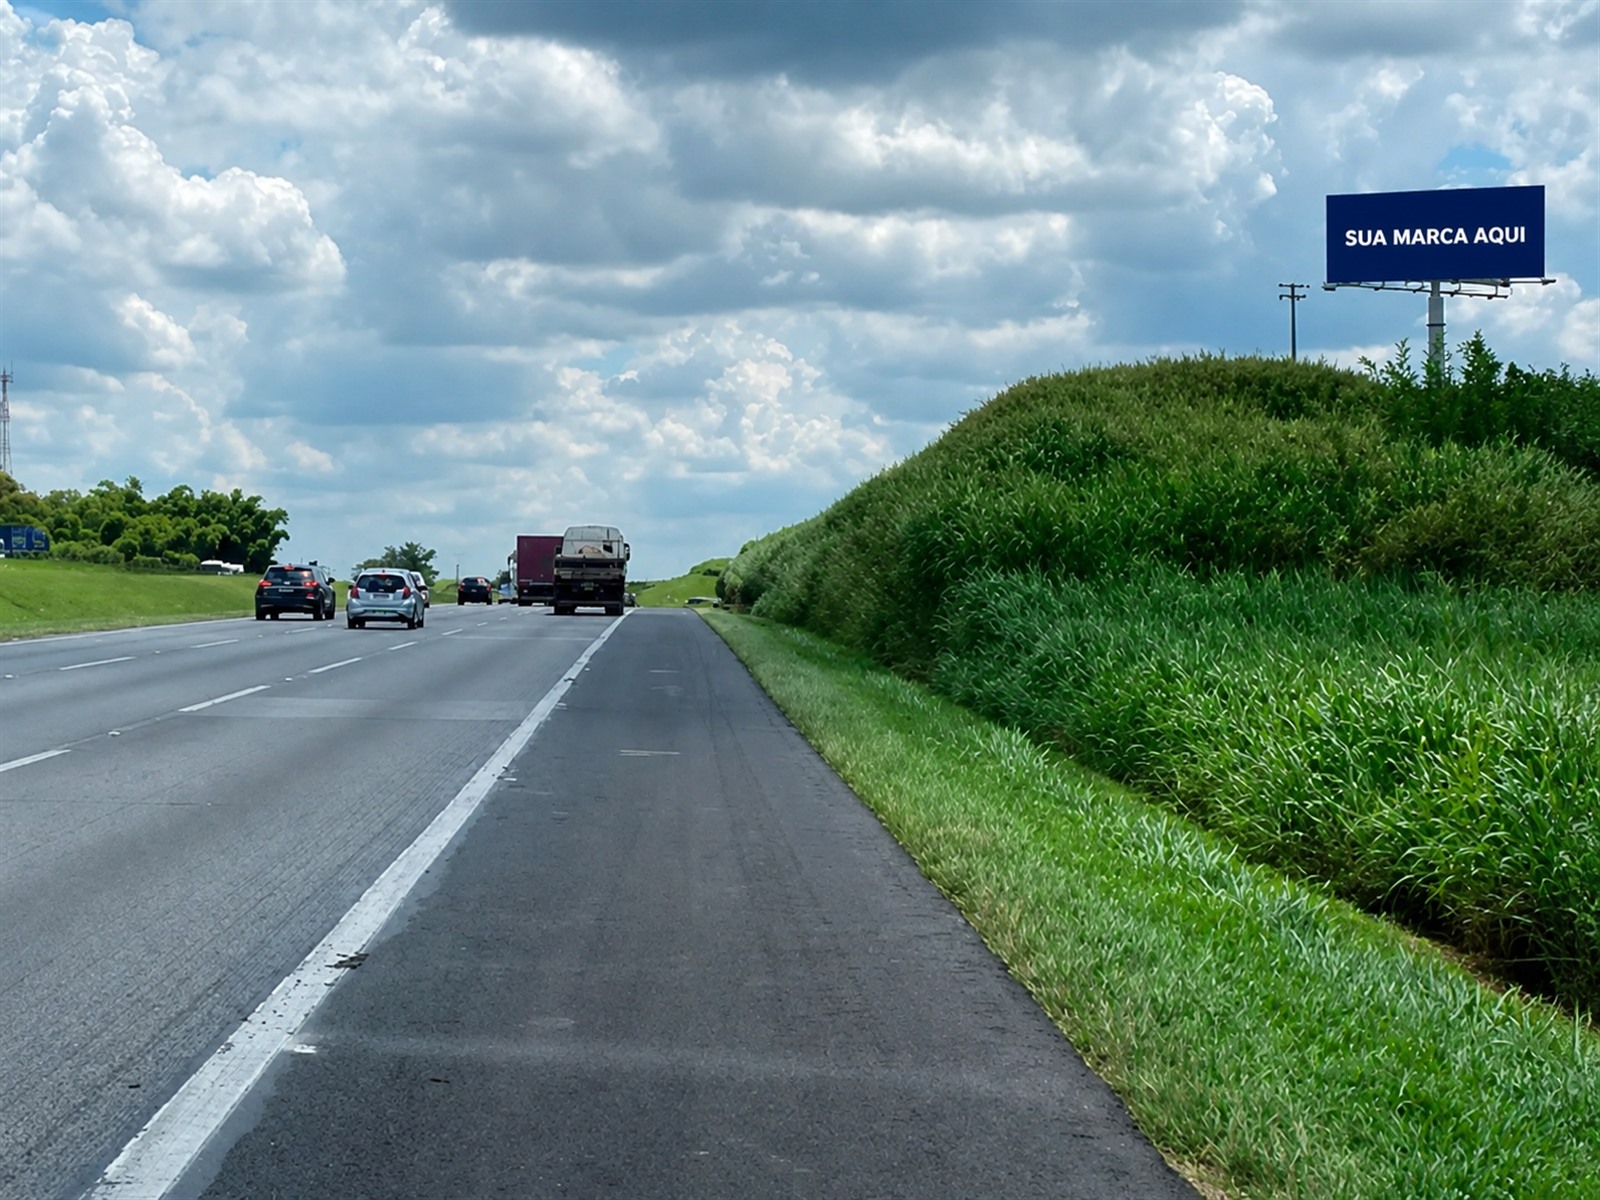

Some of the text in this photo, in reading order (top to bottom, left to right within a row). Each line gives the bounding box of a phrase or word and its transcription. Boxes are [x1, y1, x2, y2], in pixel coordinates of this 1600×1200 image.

[1345, 226, 1526, 247] SUA MARCA AQUI
